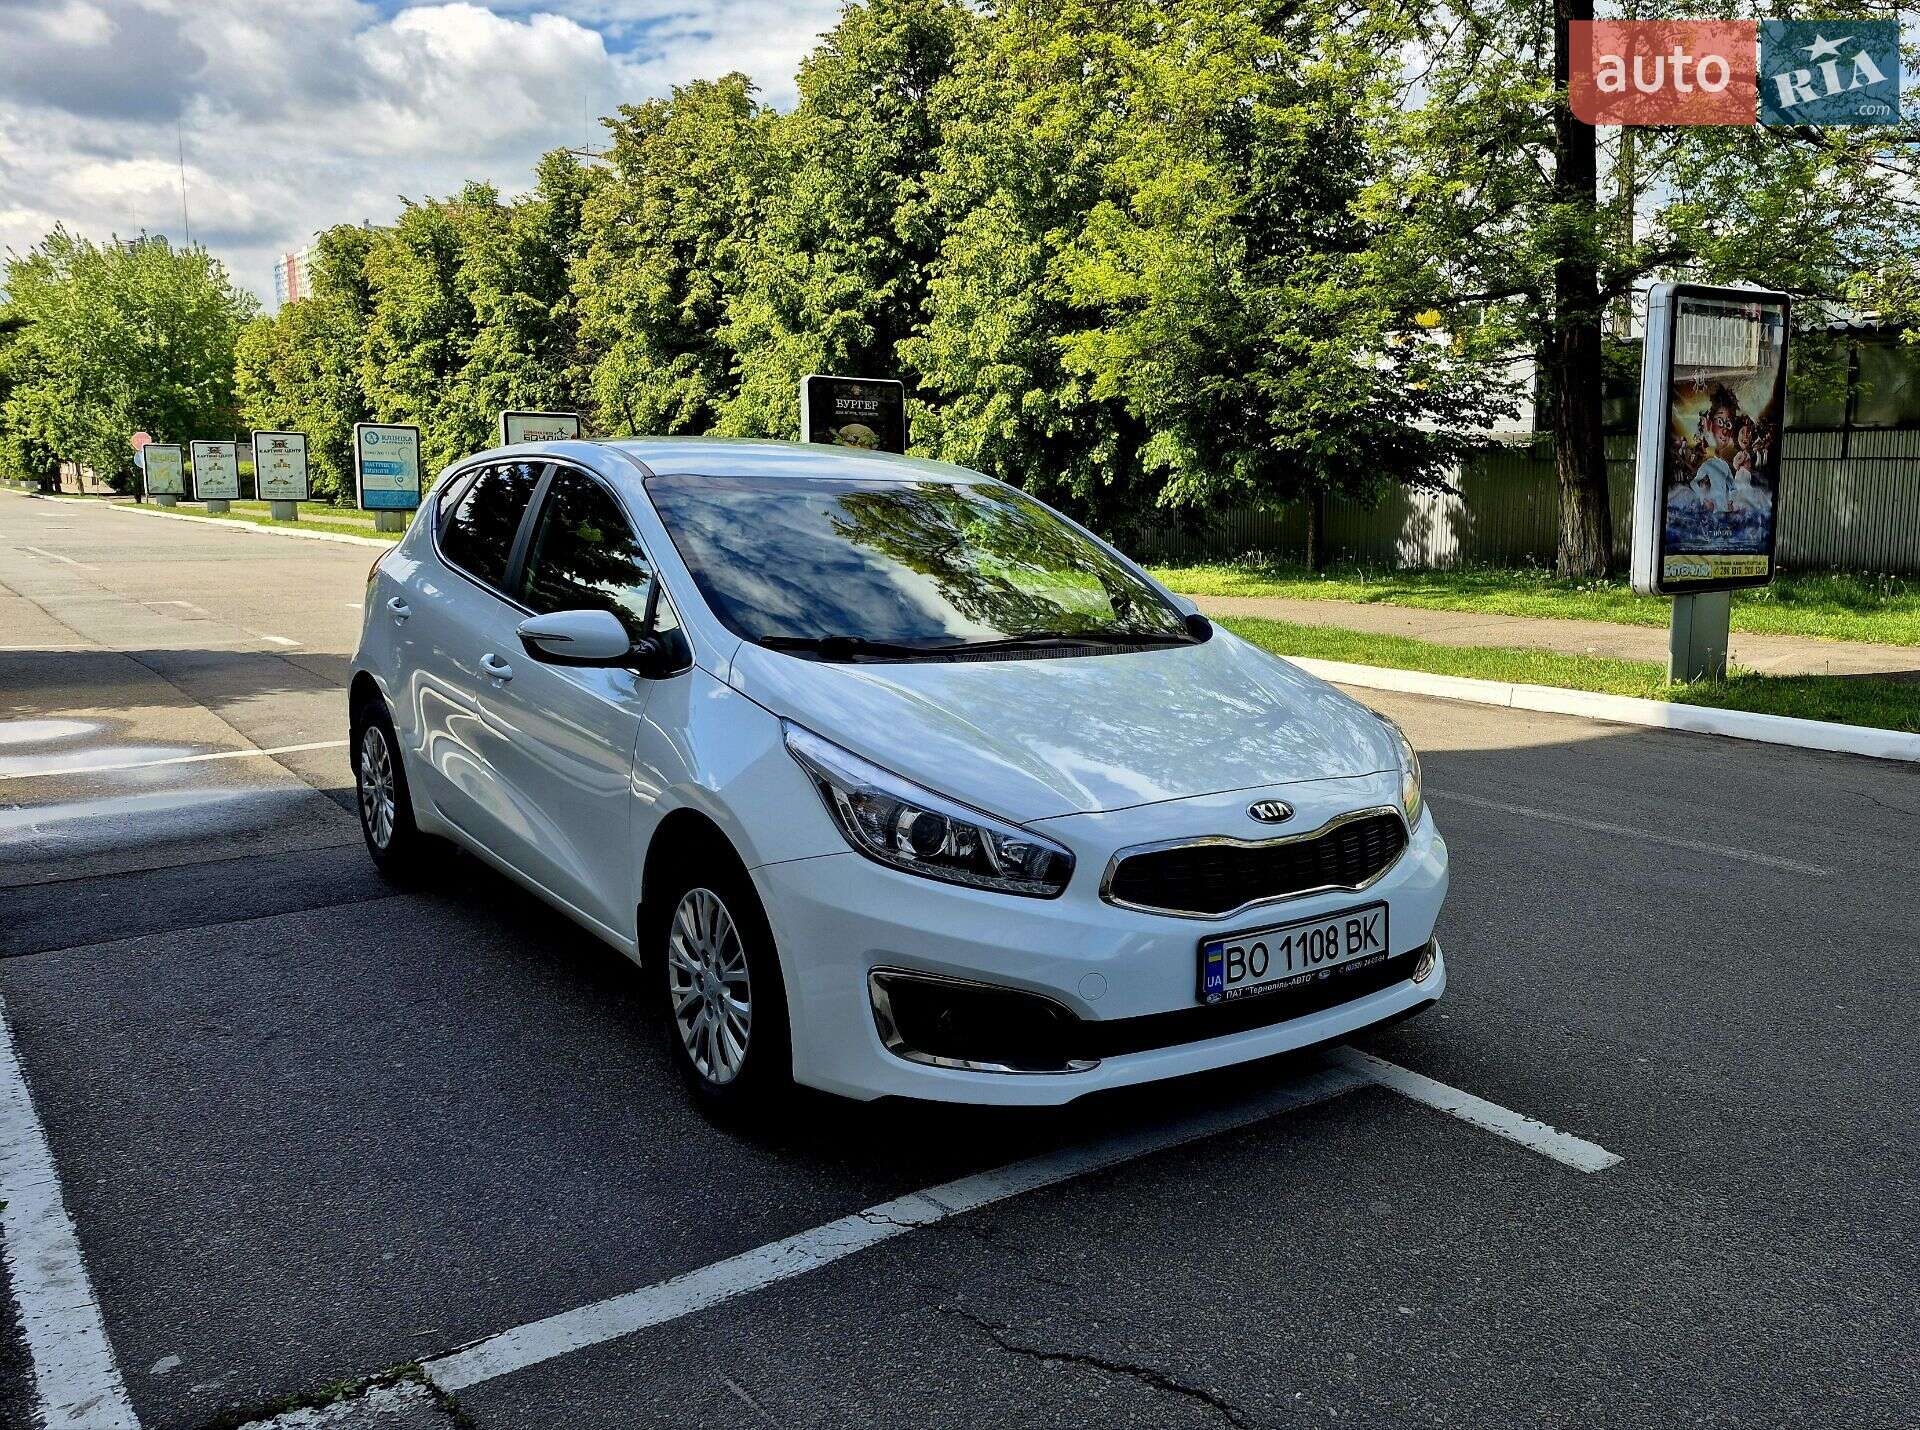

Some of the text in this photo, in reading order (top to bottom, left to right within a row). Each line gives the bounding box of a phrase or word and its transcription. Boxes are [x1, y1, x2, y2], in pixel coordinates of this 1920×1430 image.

[835, 398, 879, 410] БУРГЕР
[1252, 802, 1292, 818] KIA
[1226, 912, 1380, 985] BO 1108 BK
[1207, 975, 1222, 988] UA
